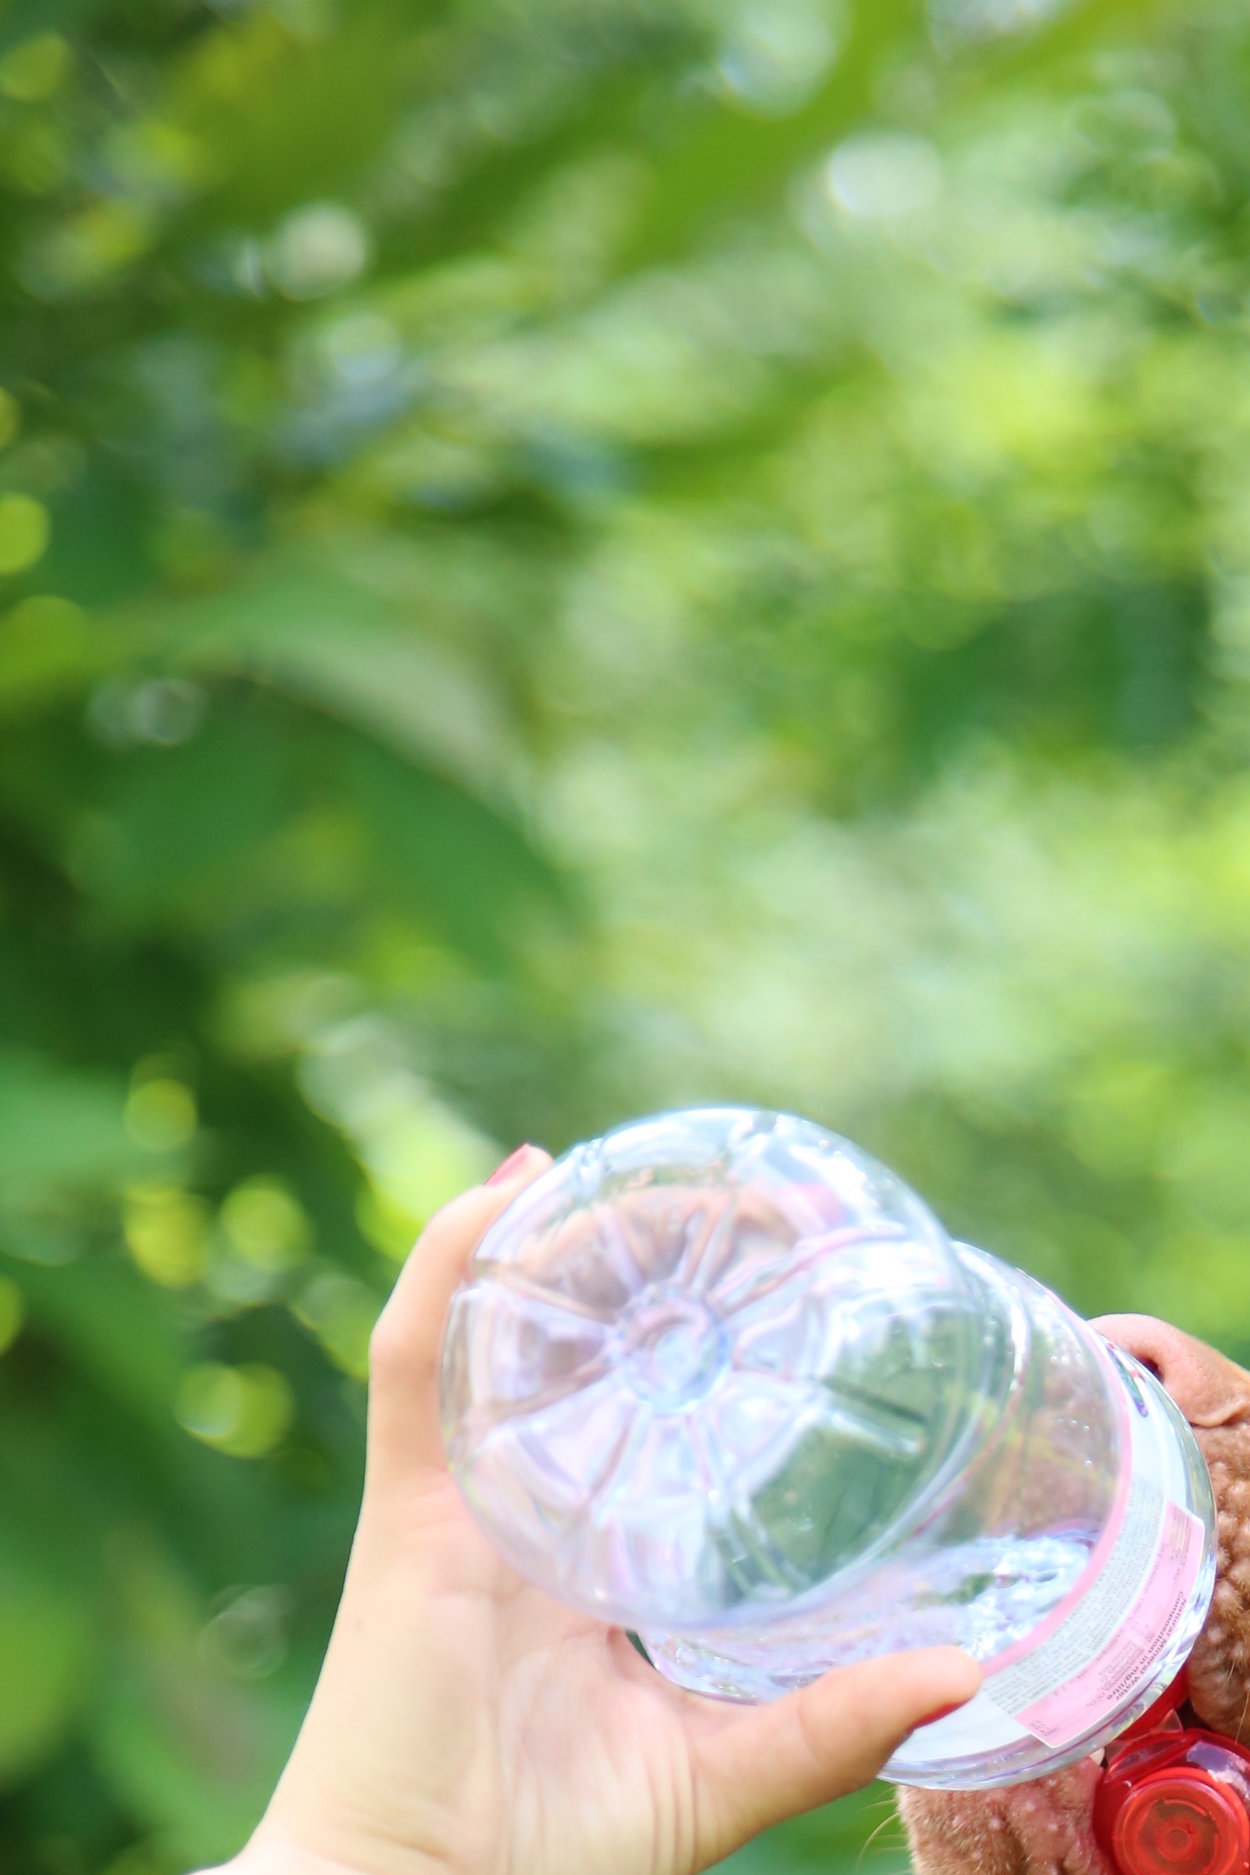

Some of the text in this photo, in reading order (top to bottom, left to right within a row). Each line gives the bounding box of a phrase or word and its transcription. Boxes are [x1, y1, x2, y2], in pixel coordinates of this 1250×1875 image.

[1147, 1590, 1183, 1653] Composition
[1166, 1598, 1186, 1636] Natural
[1138, 1638, 1166, 1674] Mineral
[1139, 1654, 1148, 1665] in
[1106, 1665, 1139, 1700] mg/litre
[1115, 1675, 1140, 1701] Water
